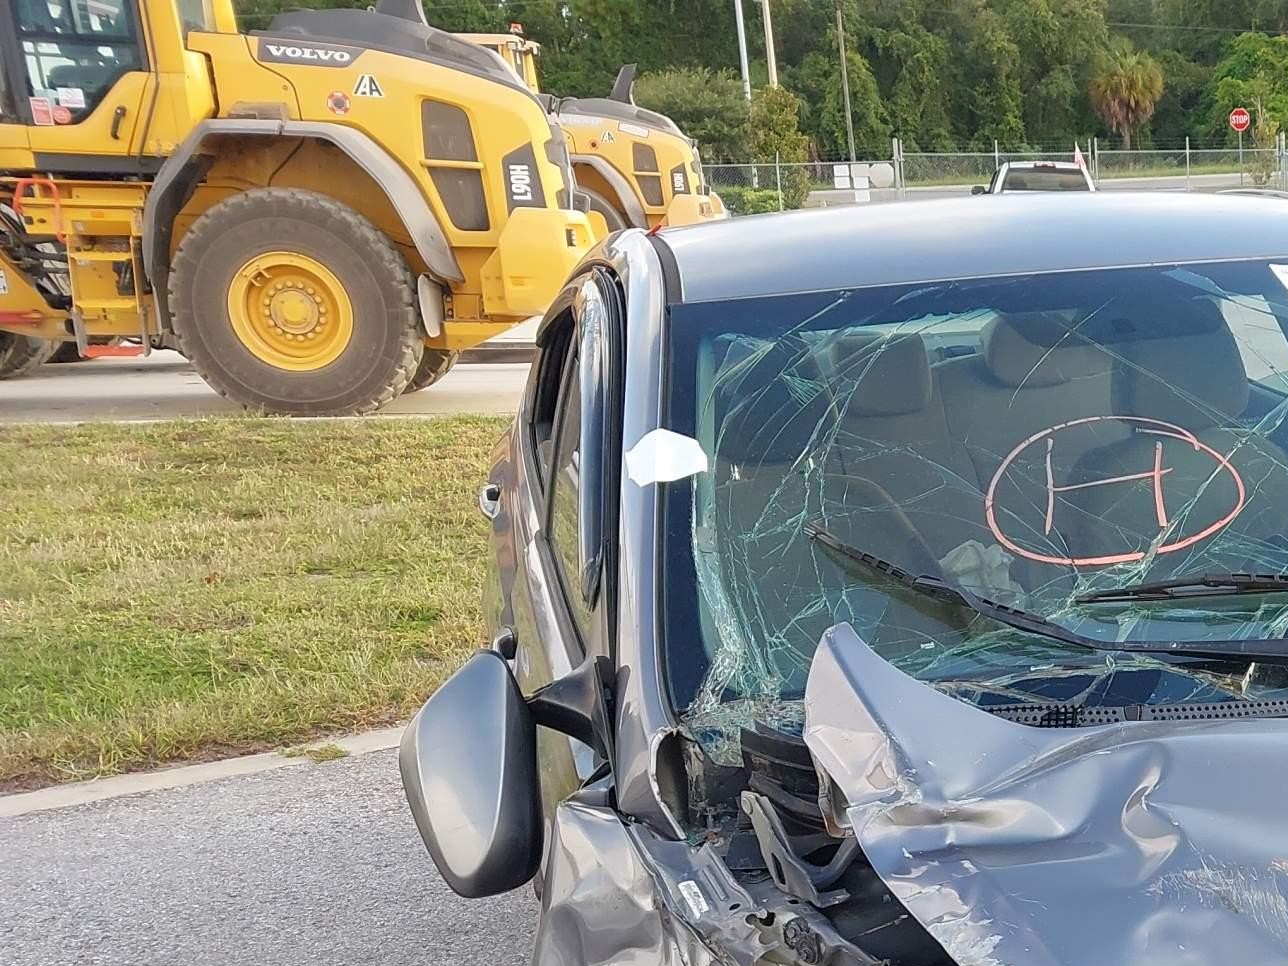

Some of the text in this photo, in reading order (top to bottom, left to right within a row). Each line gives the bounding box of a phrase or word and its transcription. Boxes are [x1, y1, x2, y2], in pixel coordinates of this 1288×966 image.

[265, 44, 351, 61] VOLVO
[1231, 115, 1248, 124] STOP
[508, 164, 532, 200] L90H
[673, 172, 685, 191] L90H
